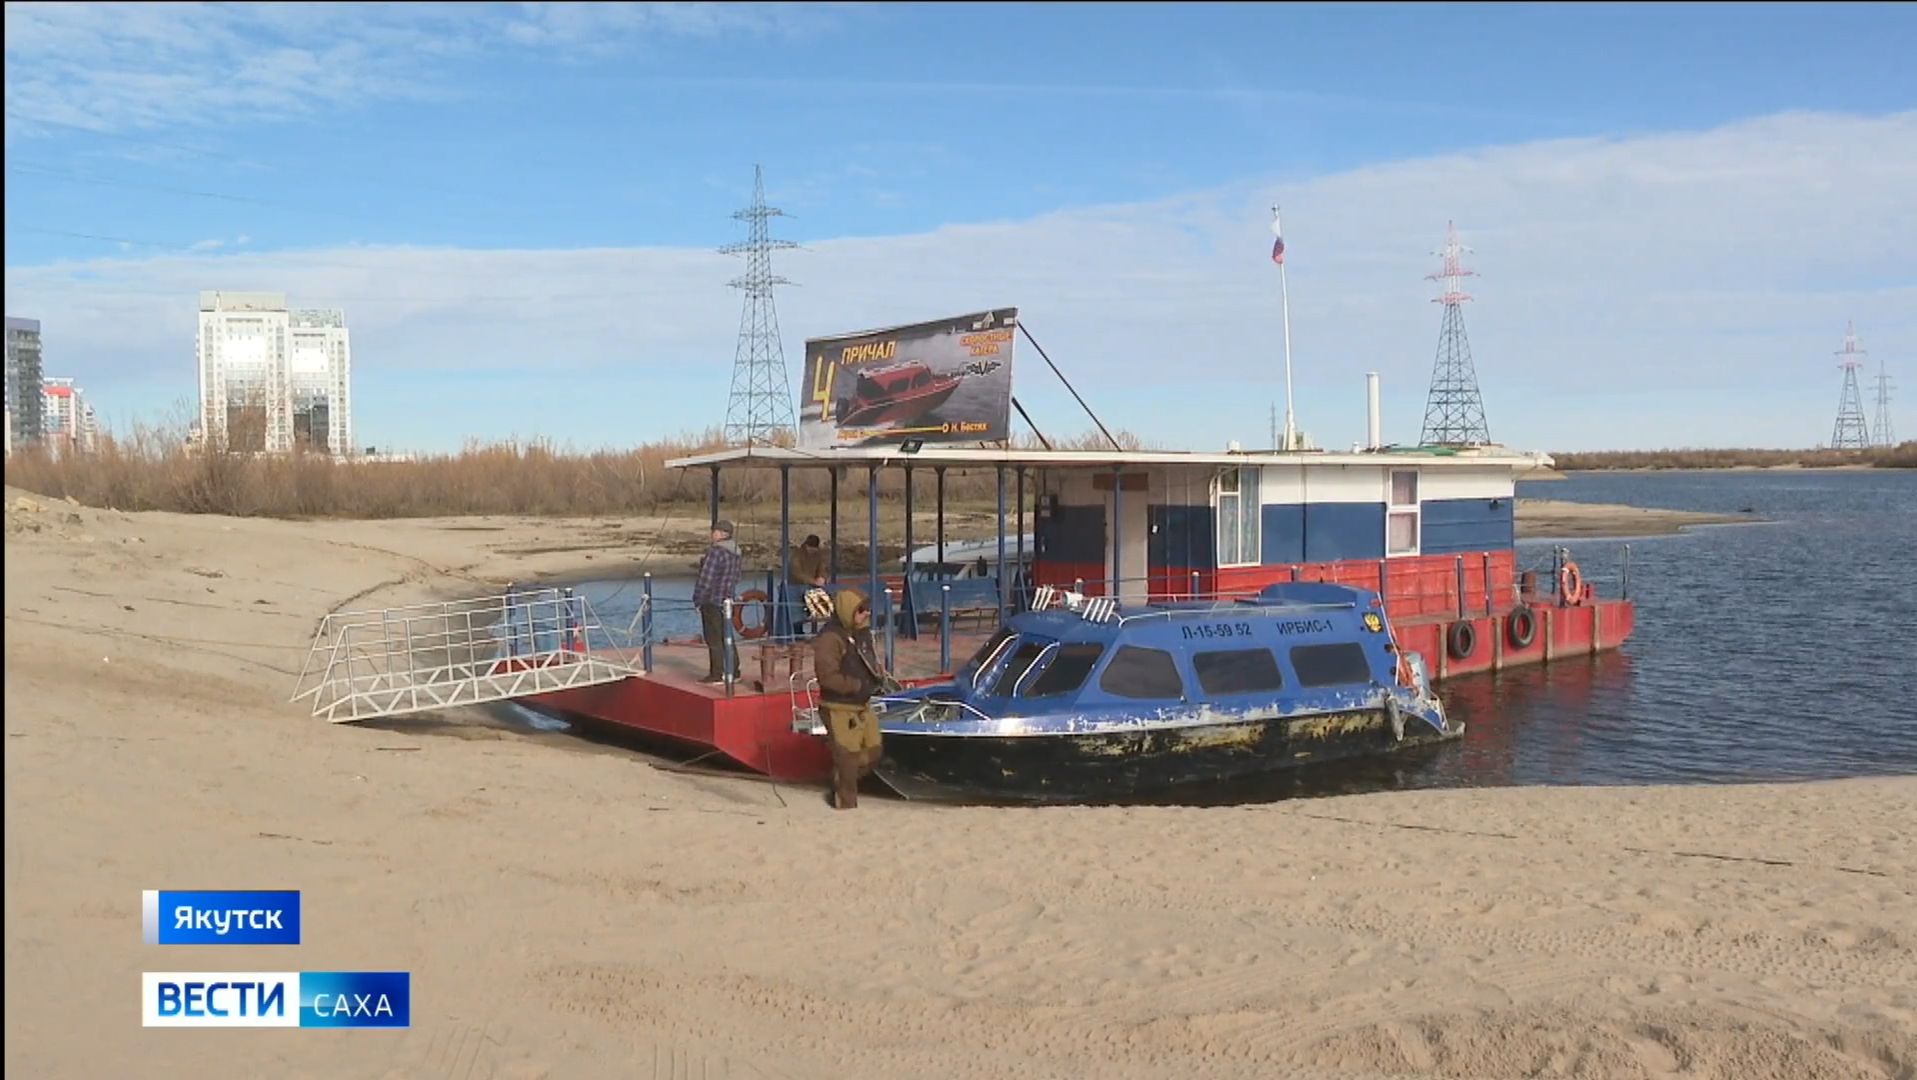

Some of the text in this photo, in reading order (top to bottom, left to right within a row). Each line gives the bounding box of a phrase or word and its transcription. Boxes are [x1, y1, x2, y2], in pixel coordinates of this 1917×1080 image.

[841, 340, 897, 365] ПРИЧАЛ
[1235, 622, 1252, 636] 52
[1276, 619, 1334, 635] ИРБИС-1
